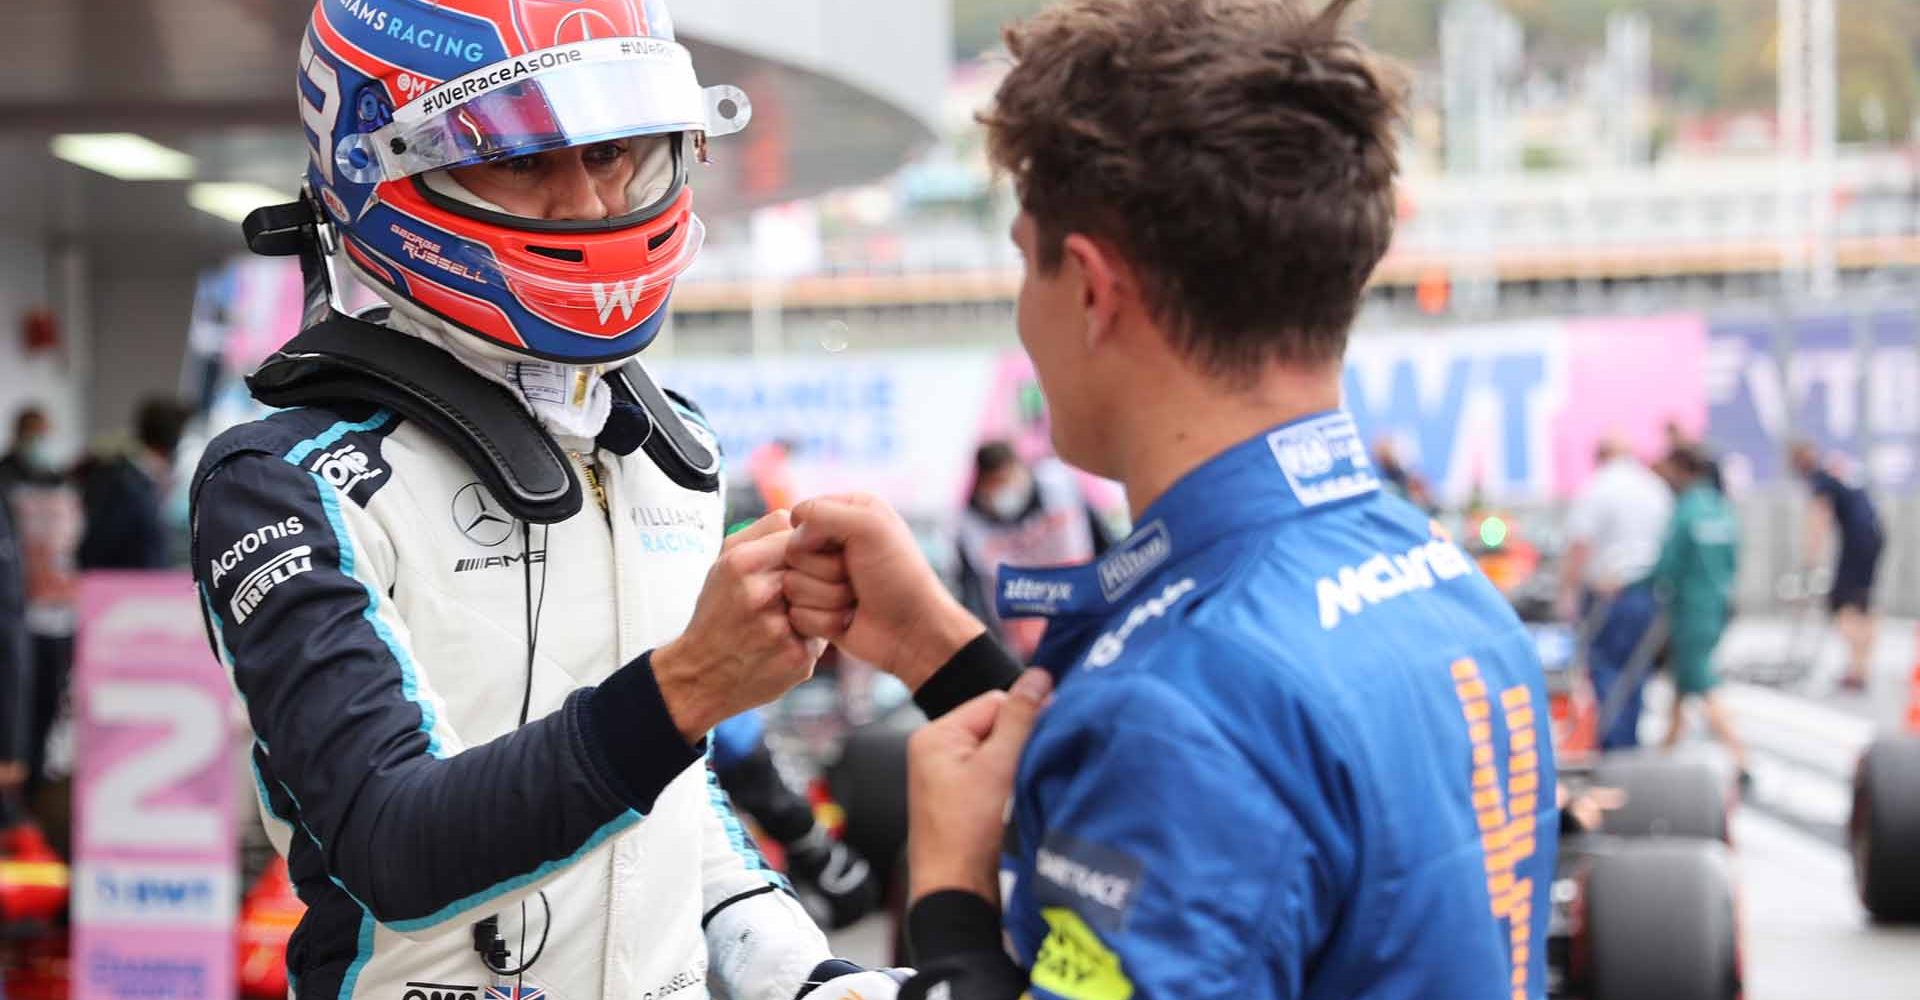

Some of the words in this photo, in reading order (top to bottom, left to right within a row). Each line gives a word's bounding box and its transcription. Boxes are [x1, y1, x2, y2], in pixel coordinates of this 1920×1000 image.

[387, 17, 484, 62] RACING
[422, 47, 583, 115] #WeRaceAsOne
[390, 223, 442, 254] GEORGE
[402, 240, 488, 285] RUSSELL
[210, 516, 304, 589] Acronis
[484, 550, 546, 569] AMG
[1101, 537, 1163, 590] Hilton
[229, 545, 313, 625] PIRELLI
[86, 683, 227, 847] 2
